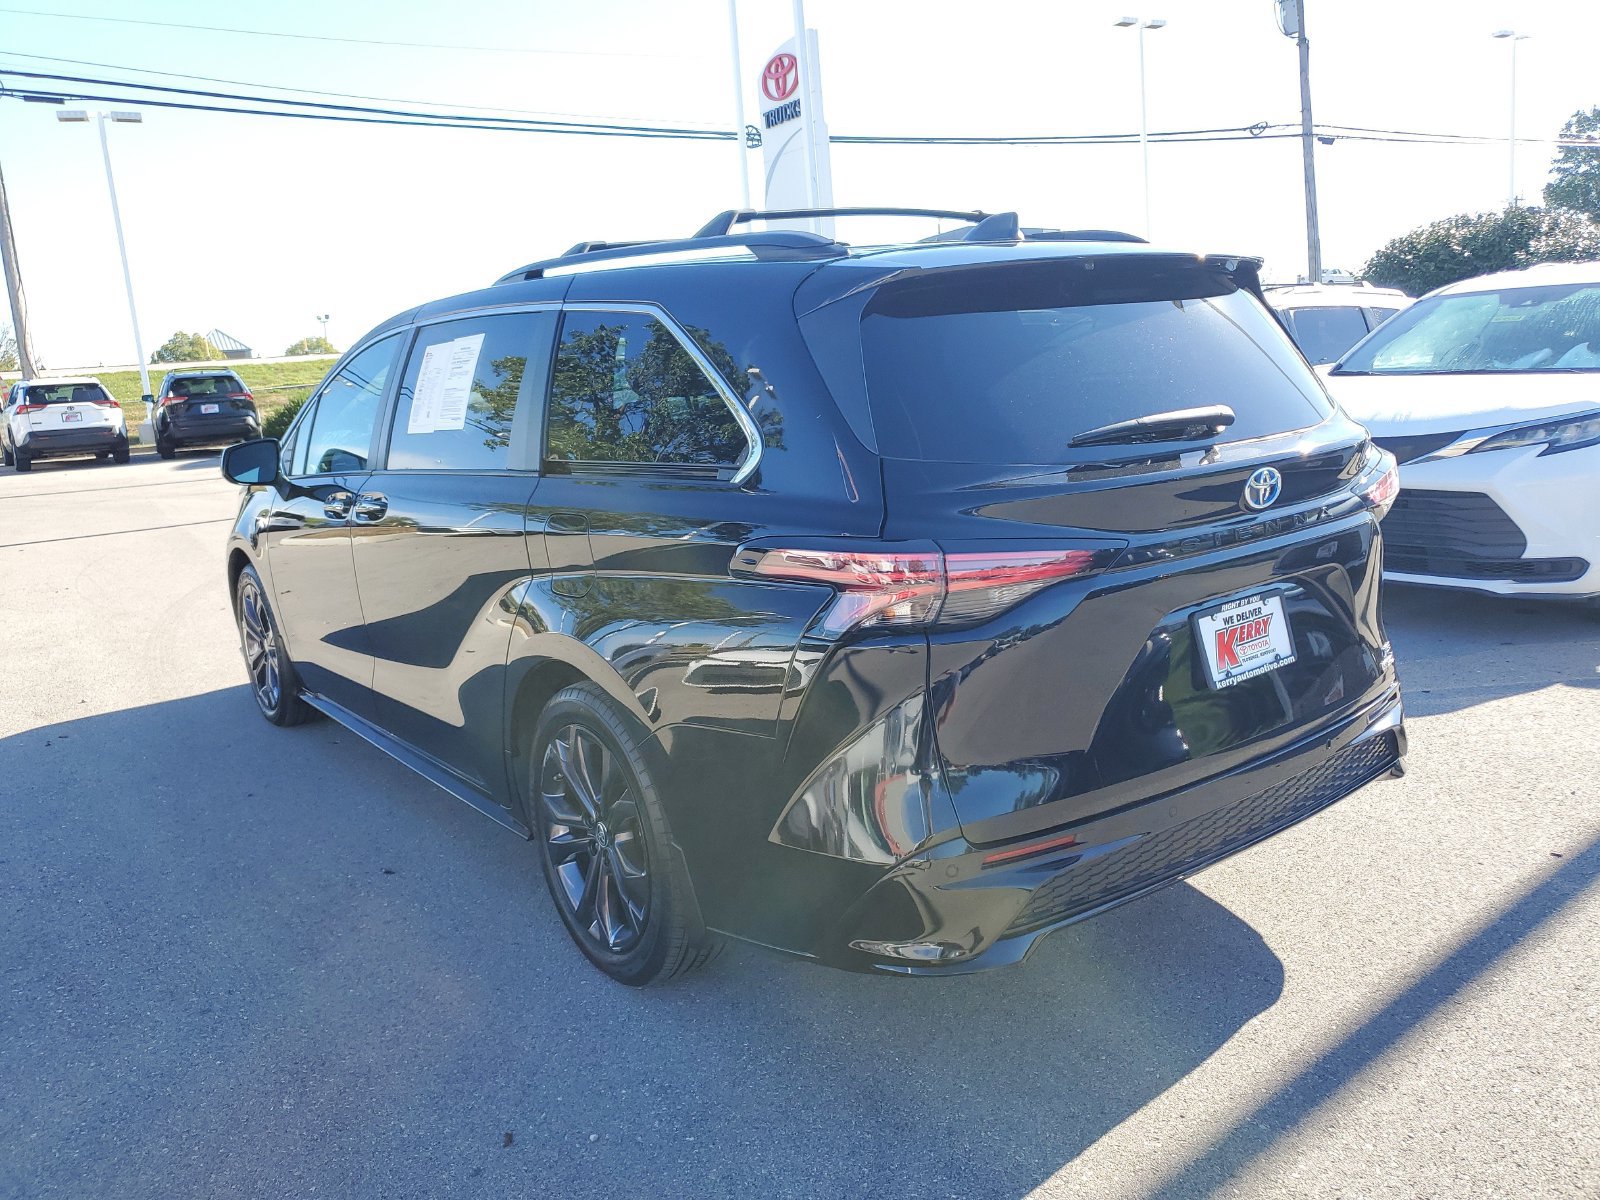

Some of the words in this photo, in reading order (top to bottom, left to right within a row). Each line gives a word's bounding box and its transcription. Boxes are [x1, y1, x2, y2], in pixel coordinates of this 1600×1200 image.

[763, 98, 801, 129] TRUCKS
[1180, 505, 1333, 552] SIENNA
[1221, 600, 1240, 612] RIGHT
[1240, 598, 1249, 607] BY
[1249, 595, 1261, 604] YOU
[1223, 616, 1235, 626] WE
[1236, 606, 1263, 622] DELIVER
[1216, 614, 1272, 673] KERRY
[1247, 639, 1270, 652] TOYOTA
[1215, 655, 1295, 689] kerryautomotive.com
